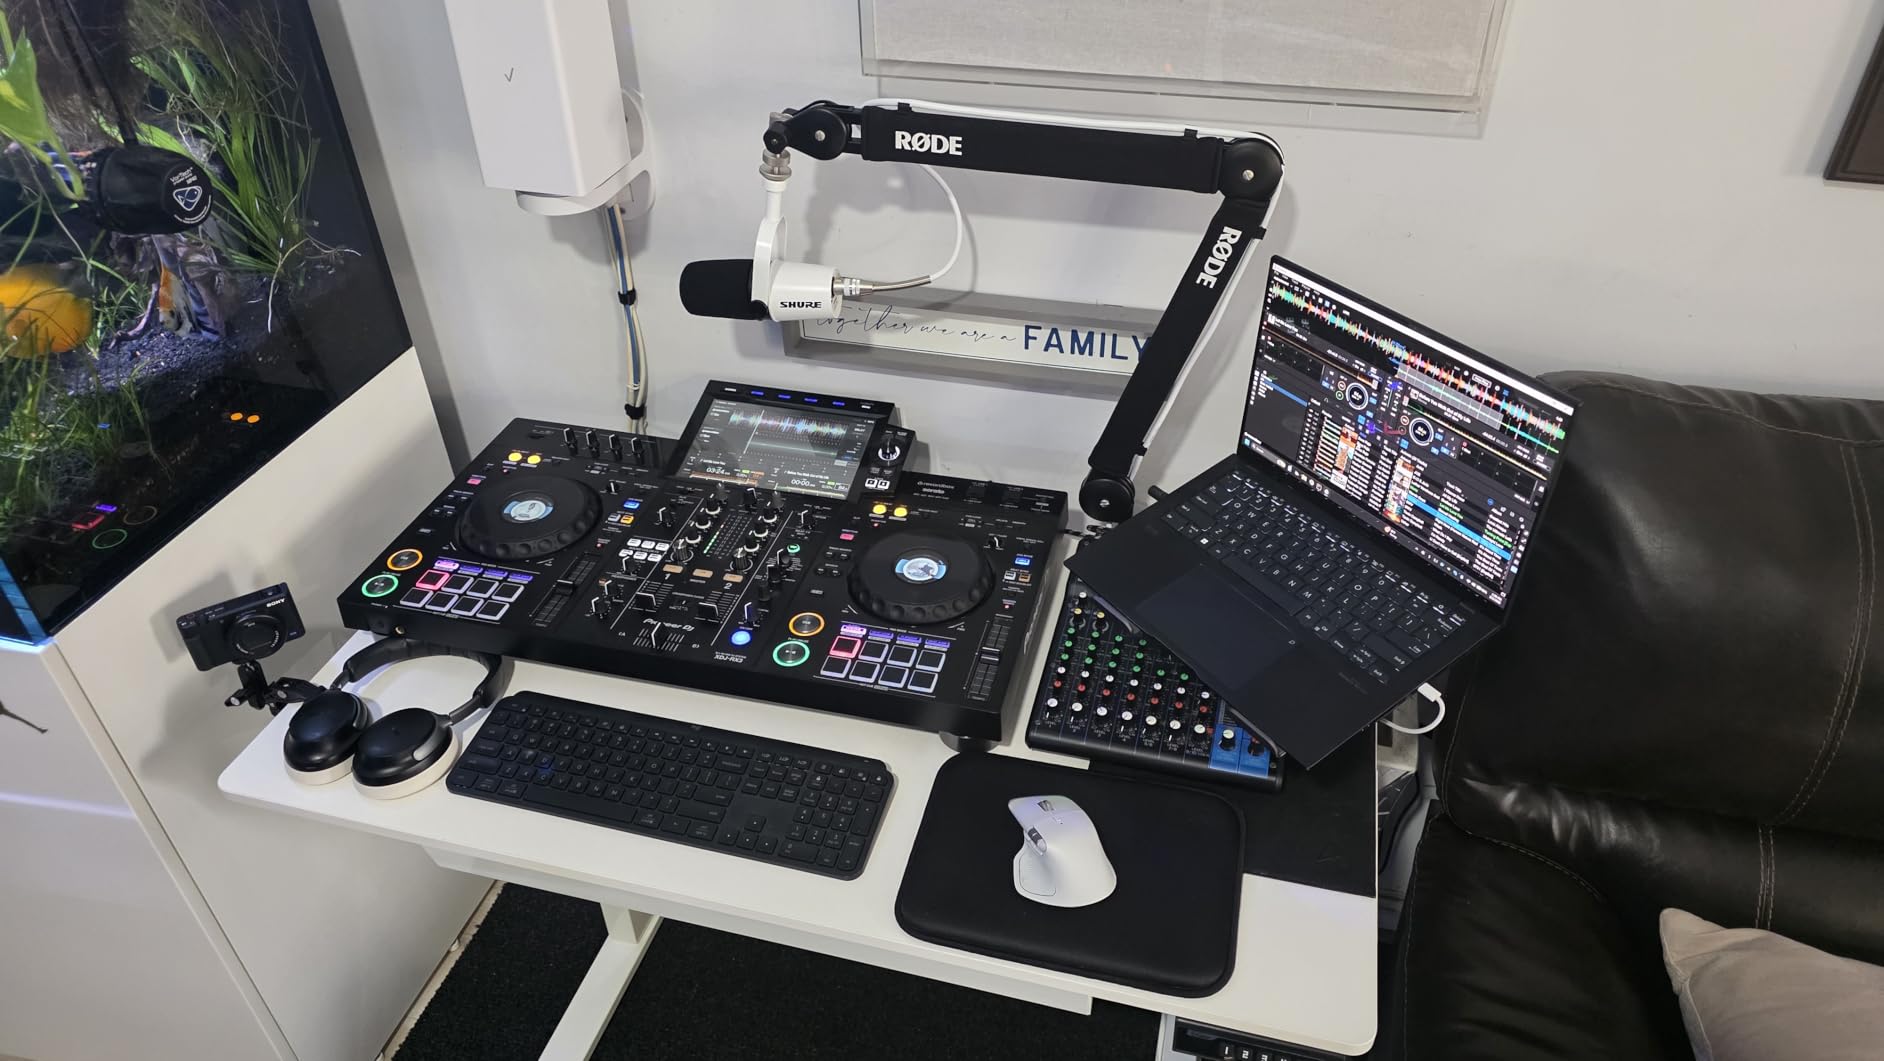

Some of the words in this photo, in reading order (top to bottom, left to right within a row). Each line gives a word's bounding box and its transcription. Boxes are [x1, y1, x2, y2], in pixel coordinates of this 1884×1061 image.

[895, 130, 962, 156] RØDE
[1196, 226, 1242, 288] RØDE
[1024, 324, 1152, 361] FAMILY
[724, 582, 732, 590] 2
[266, 598, 286, 607] SONY
